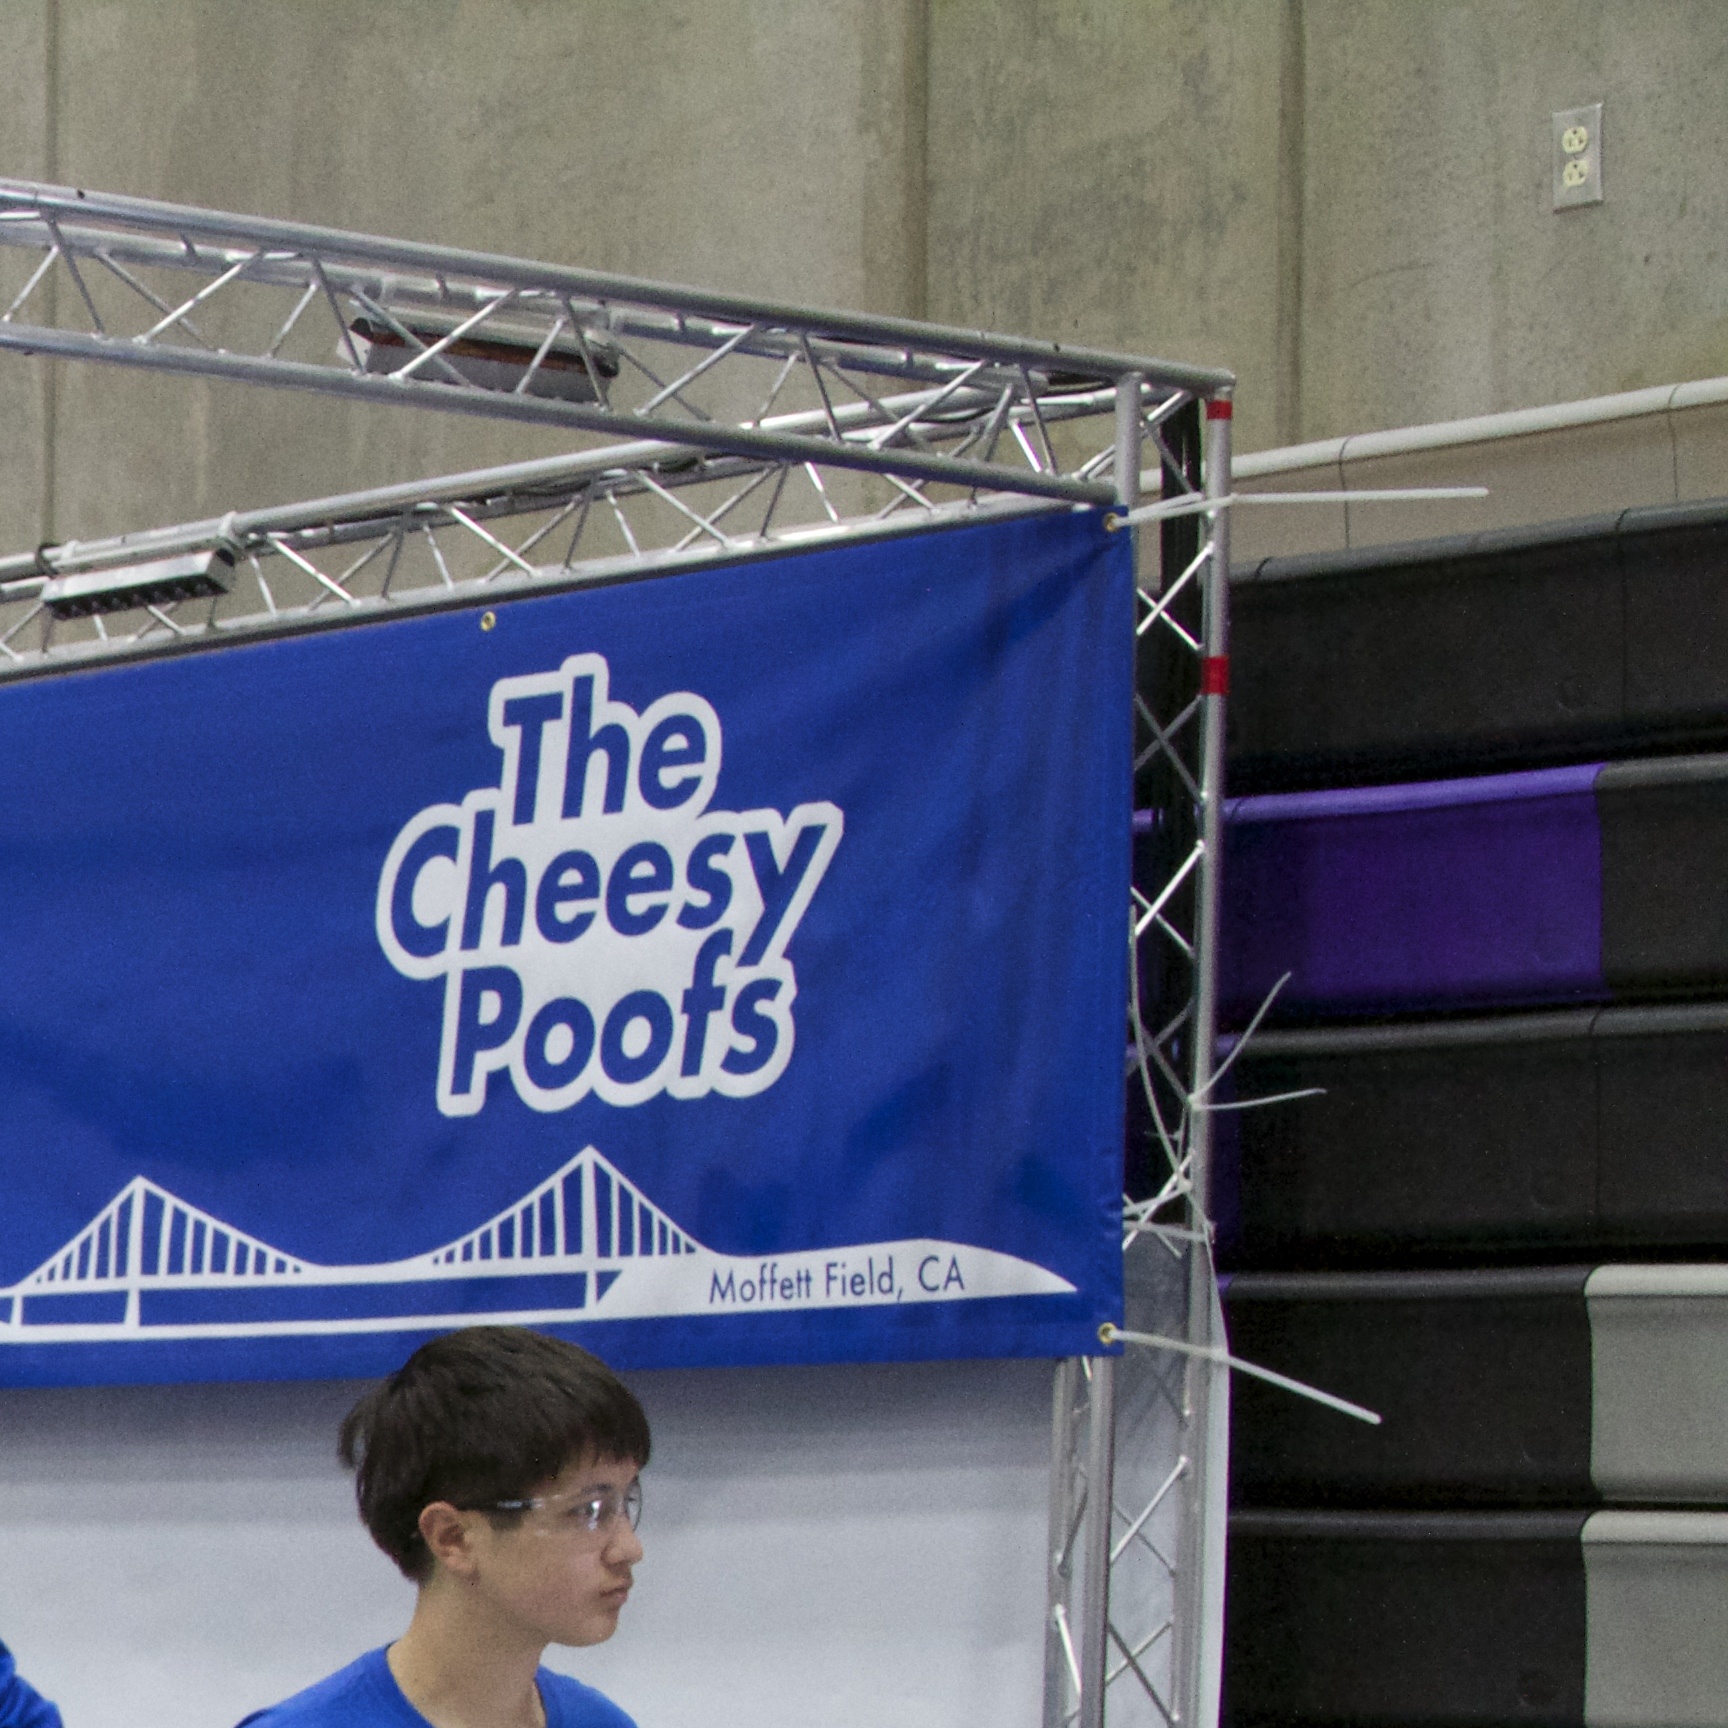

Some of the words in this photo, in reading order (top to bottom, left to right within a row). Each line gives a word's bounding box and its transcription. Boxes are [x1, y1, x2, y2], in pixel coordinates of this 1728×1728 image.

[501, 672, 709, 827] The
[389, 807, 830, 970] Cheesy
[449, 927, 784, 1097] Poofs
[709, 1262, 812, 1304] Moffett
[825, 1255, 903, 1301] Field,
[918, 1254, 965, 1292] CA
